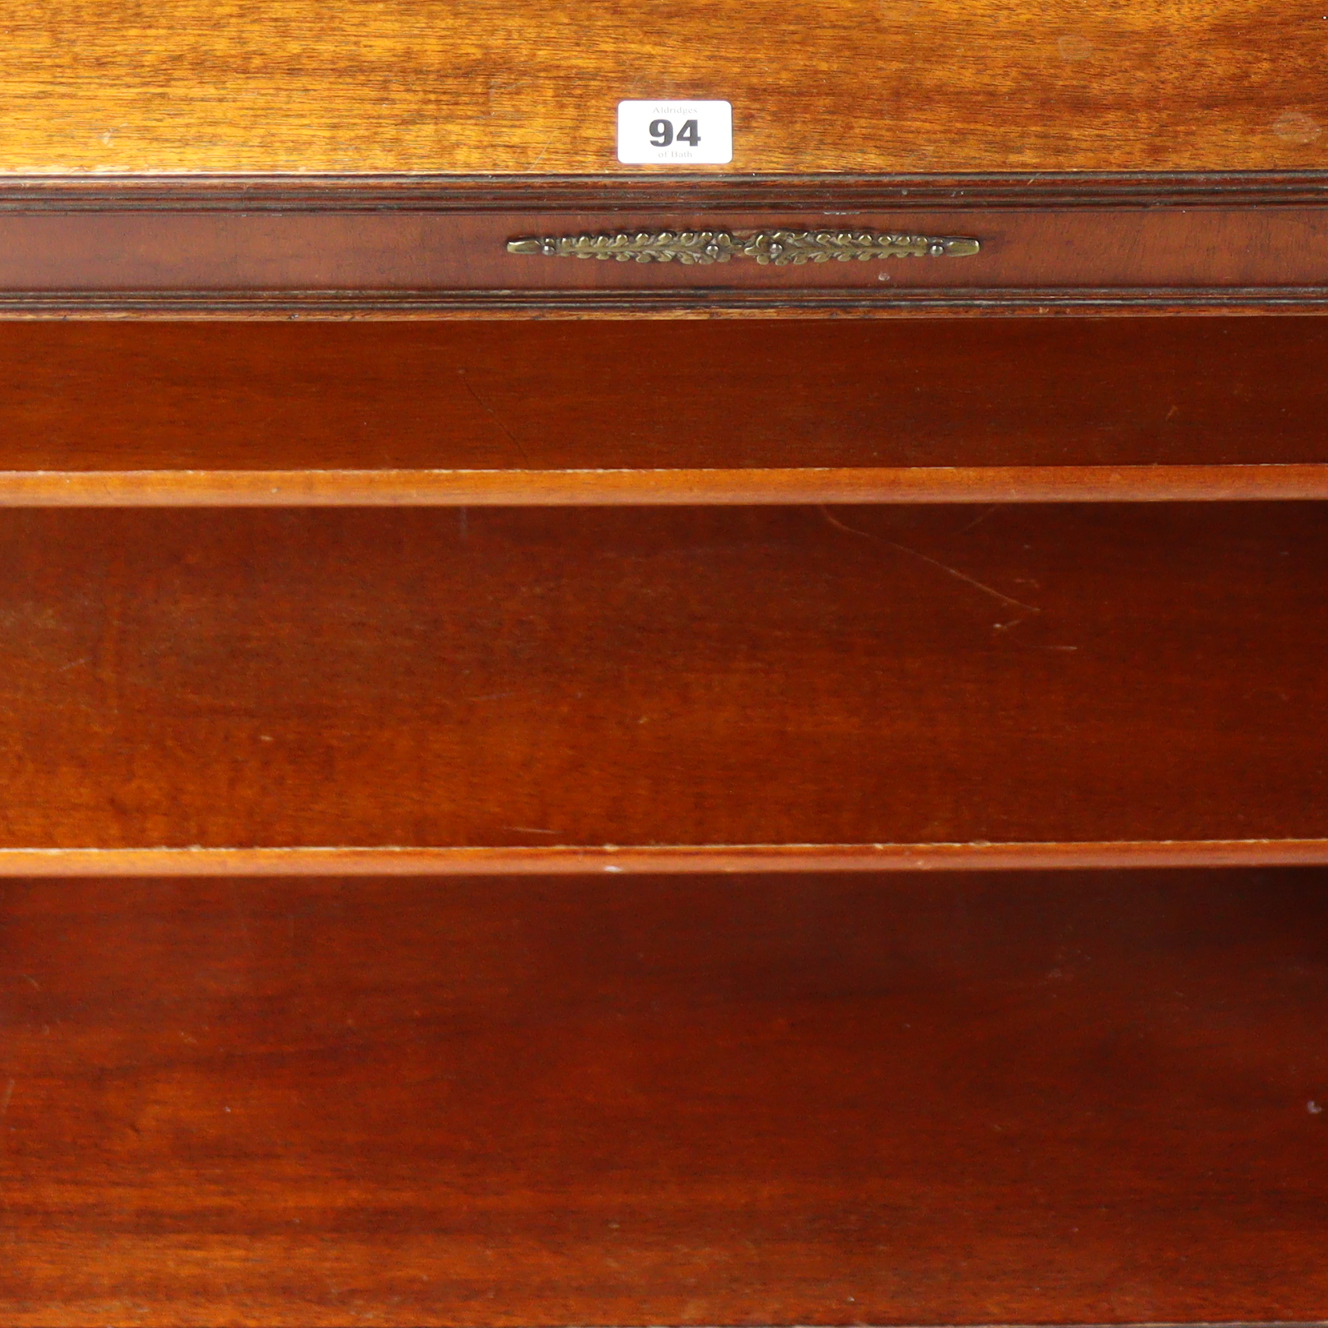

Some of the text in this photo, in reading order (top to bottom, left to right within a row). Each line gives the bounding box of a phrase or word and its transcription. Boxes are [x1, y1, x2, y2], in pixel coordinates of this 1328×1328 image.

[652, 106, 698, 115] Aldridges
[649, 119, 701, 147] 94
[658, 150, 693, 158] of Bath
